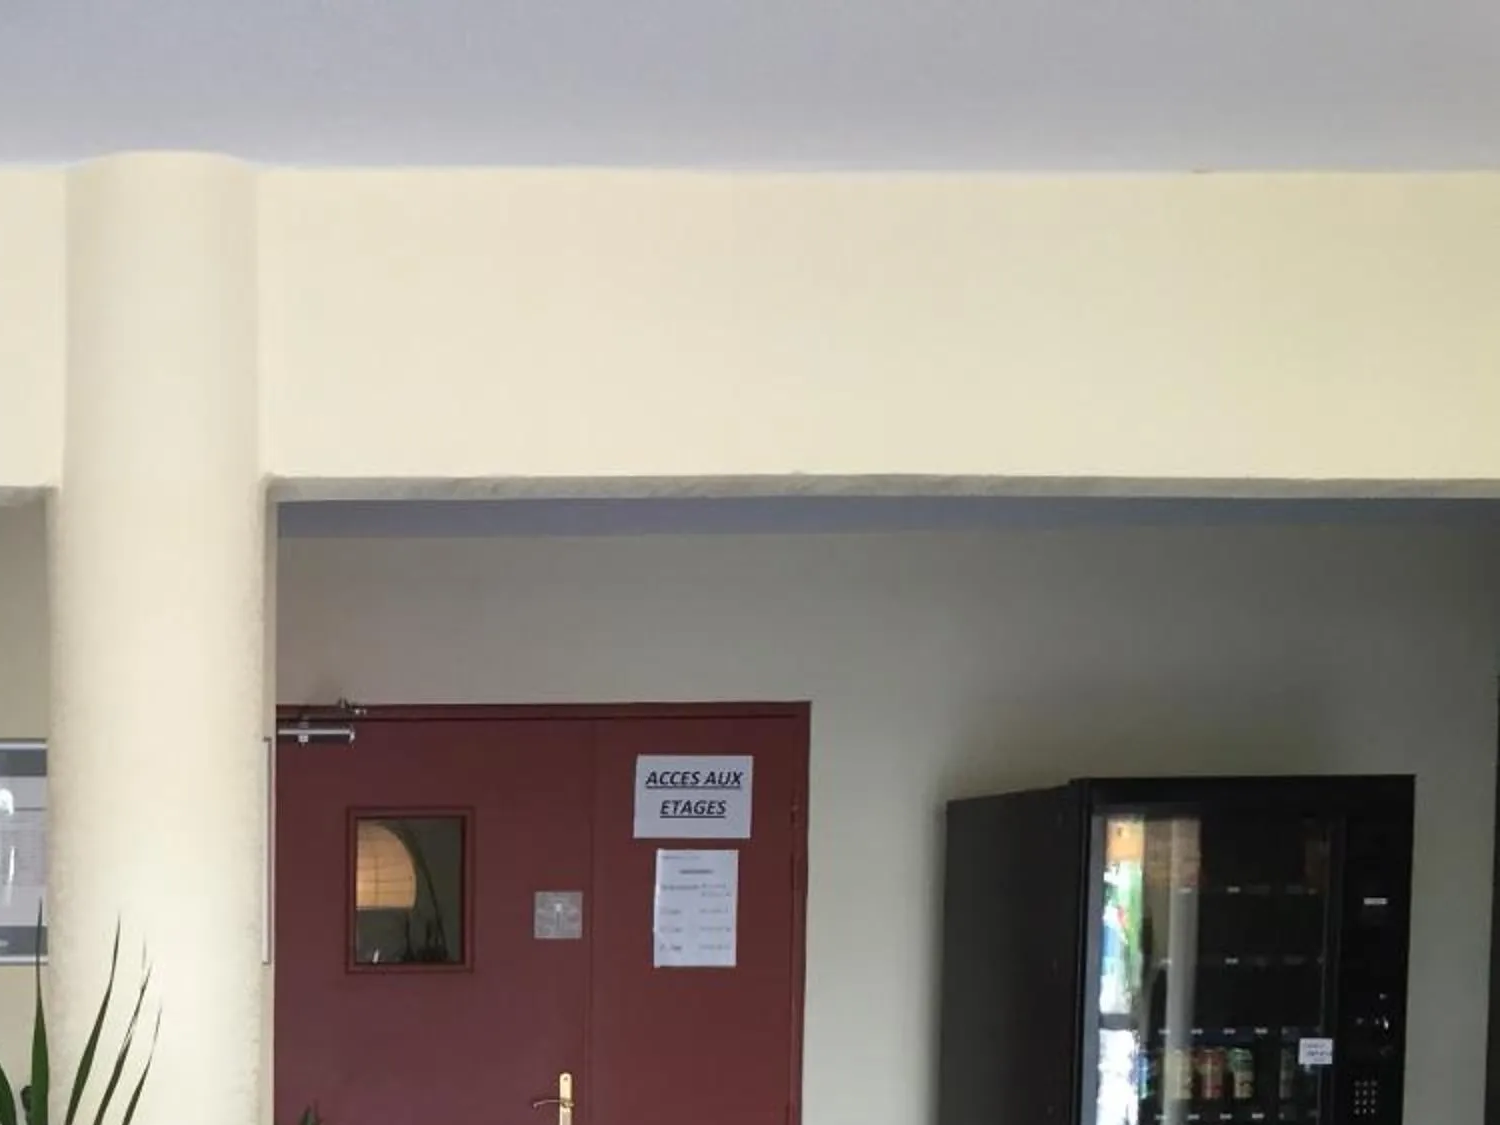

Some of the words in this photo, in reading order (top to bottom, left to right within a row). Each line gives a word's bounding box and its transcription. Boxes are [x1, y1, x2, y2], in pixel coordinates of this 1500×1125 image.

[646, 771, 701, 786] ACCES
[704, 771, 744, 786] AUX
[660, 799, 726, 816] ETAGES
